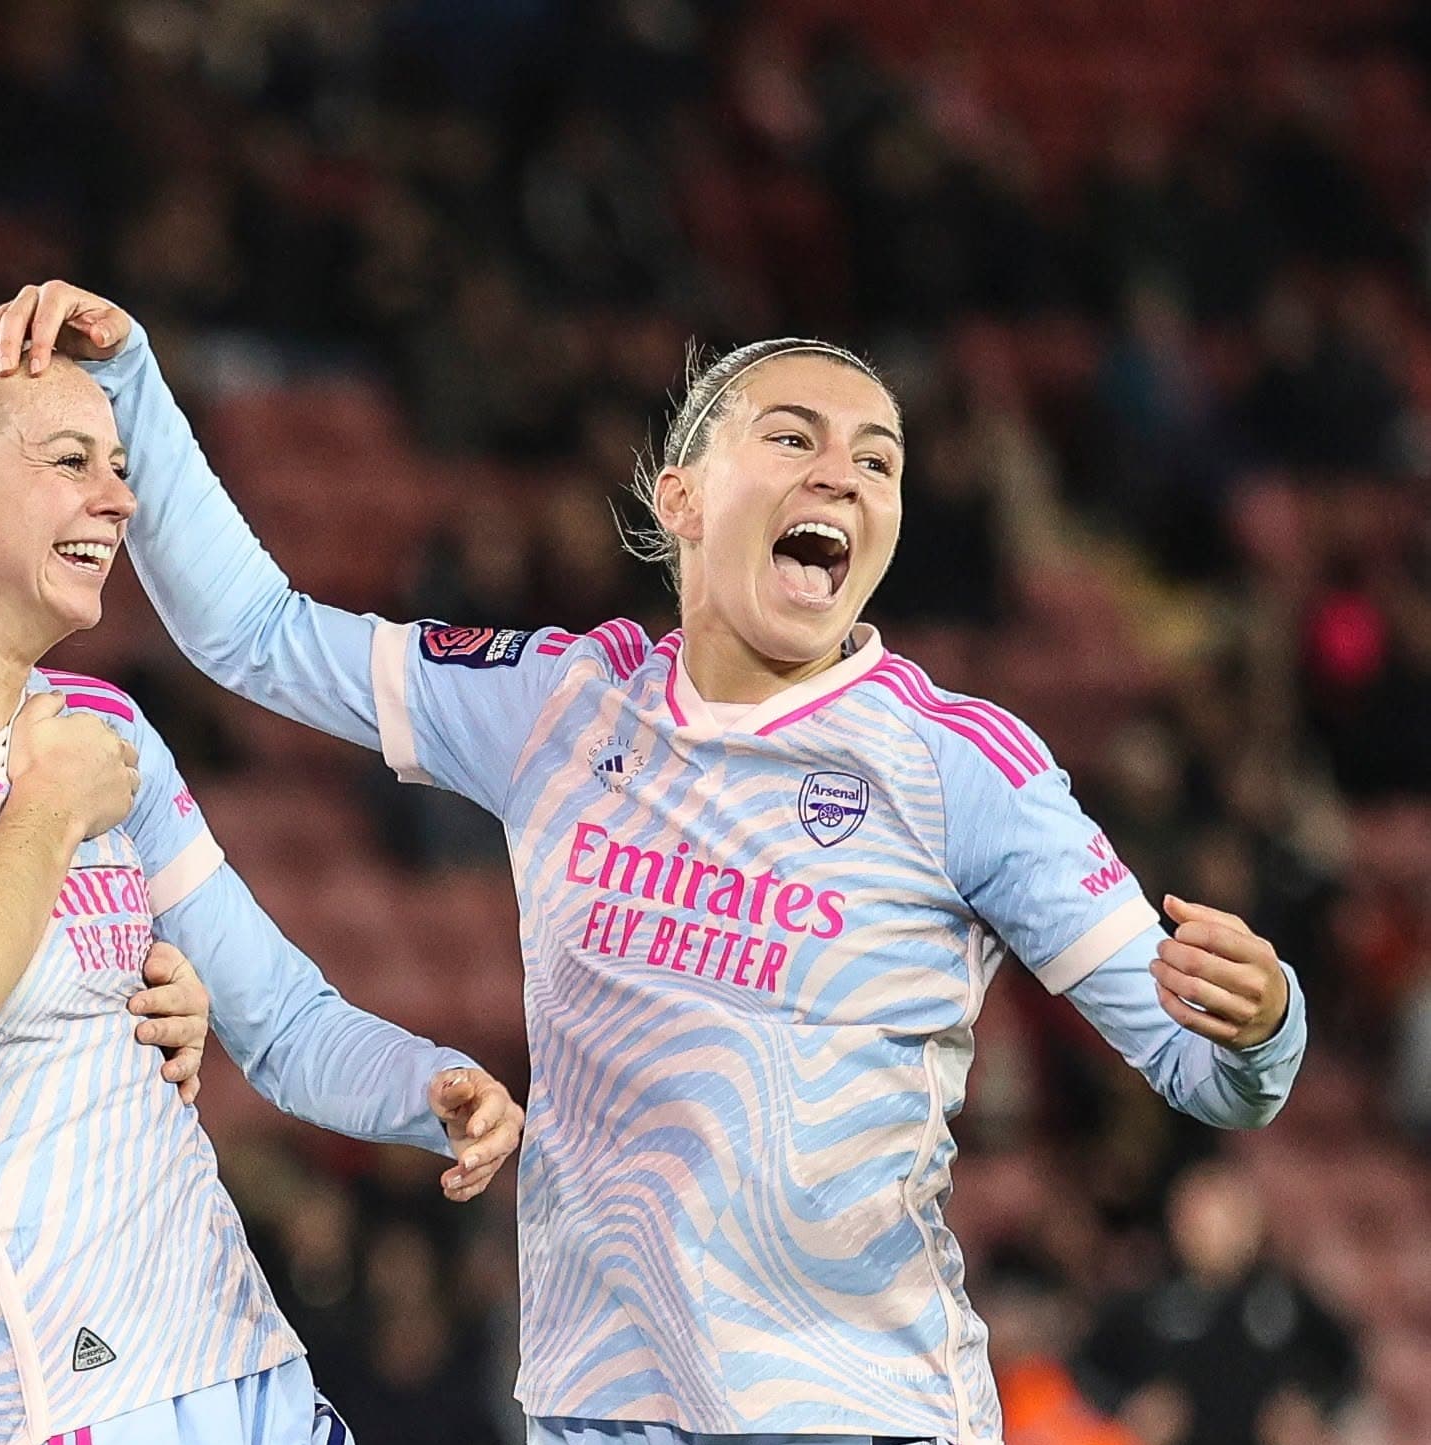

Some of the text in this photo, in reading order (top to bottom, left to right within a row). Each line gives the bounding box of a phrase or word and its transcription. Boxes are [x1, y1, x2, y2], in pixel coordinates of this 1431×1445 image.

[809, 783, 860, 801] Arsenal
[565, 822, 847, 940] Emirates
[66, 924, 110, 972] FLY
[581, 900, 788, 994] FLY BETTER
